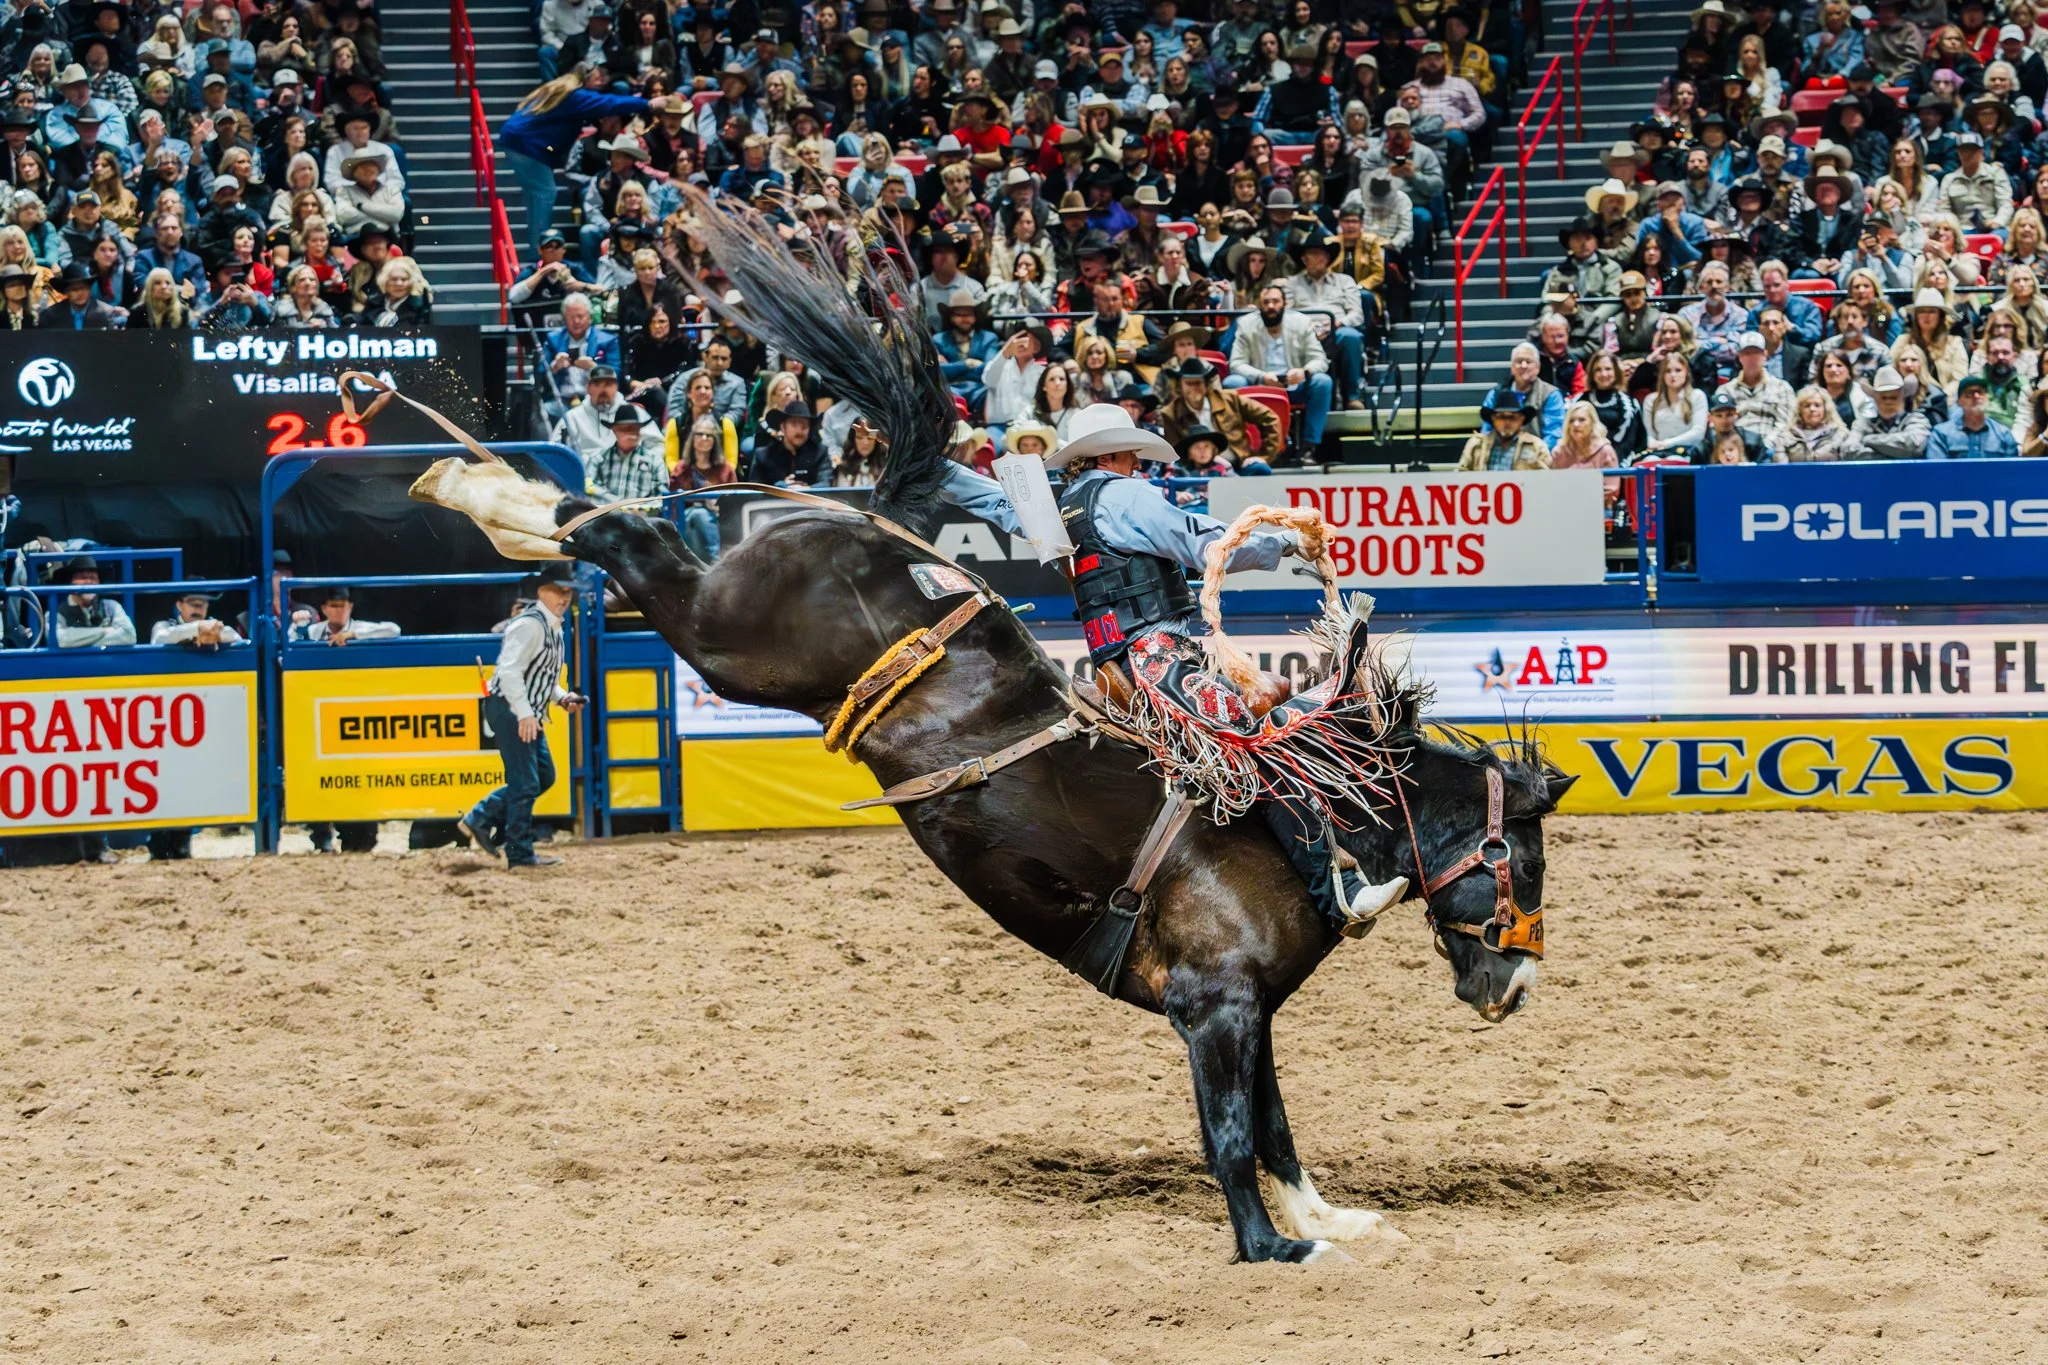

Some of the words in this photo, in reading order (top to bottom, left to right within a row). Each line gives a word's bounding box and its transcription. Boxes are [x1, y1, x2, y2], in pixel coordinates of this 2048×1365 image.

[193, 335, 288, 365] Lefty
[298, 334, 437, 360] Holman
[53, 438, 81, 451] LAS
[83, 438, 132, 451] VEGAS
[266, 411, 368, 456] 2.6
[1285, 482, 1523, 528] DURANGO
[1741, 499, 2048, 542] POLARIS
[1329, 533, 1485, 577] BOOTS
[1728, 641, 1972, 696] DRILLING
[1995, 640, 2046, 693] FL
[0, 693, 206, 755] RANGO
[0, 759, 159, 820] OOTS
[320, 774, 361, 789] MORE
[367, 773, 405, 788] THAN
[411, 772, 454, 787] GREAT
[460, 771, 505, 786] MACH
[1578, 735, 2015, 799] VEGAS
